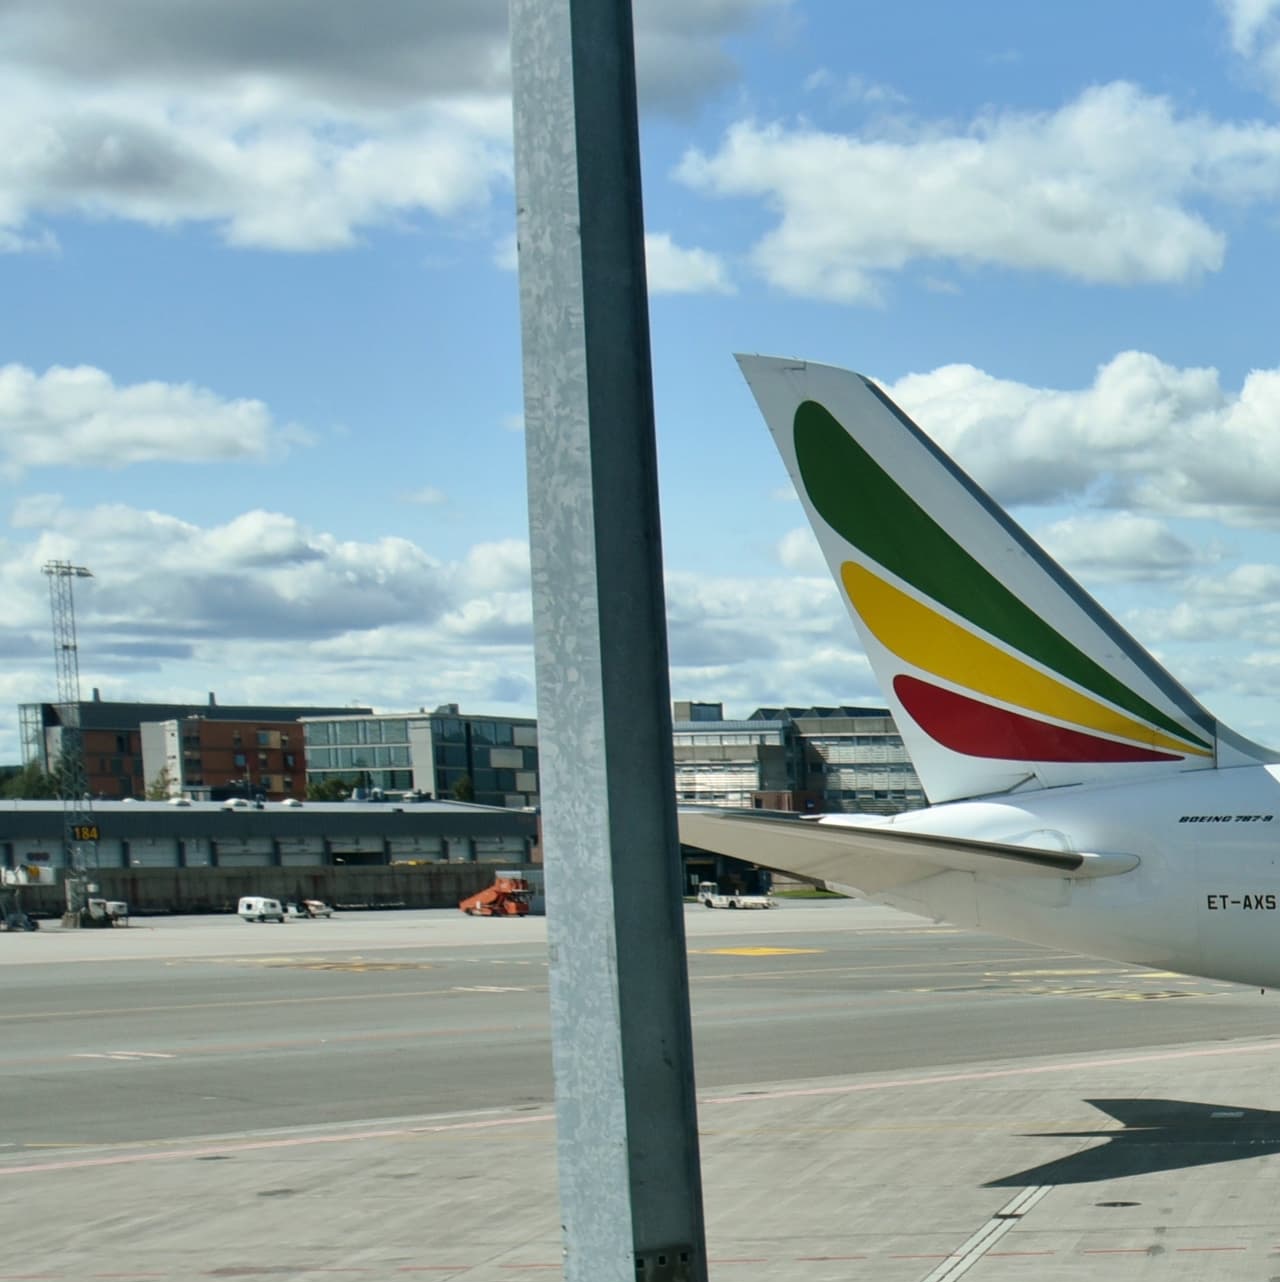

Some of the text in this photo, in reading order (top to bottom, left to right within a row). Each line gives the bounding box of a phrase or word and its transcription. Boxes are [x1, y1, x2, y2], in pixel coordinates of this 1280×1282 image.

[1178, 815, 1233, 824] BOEING
[74, 826, 99, 841] 184
[1206, 894, 1278, 911] ET-AXS
